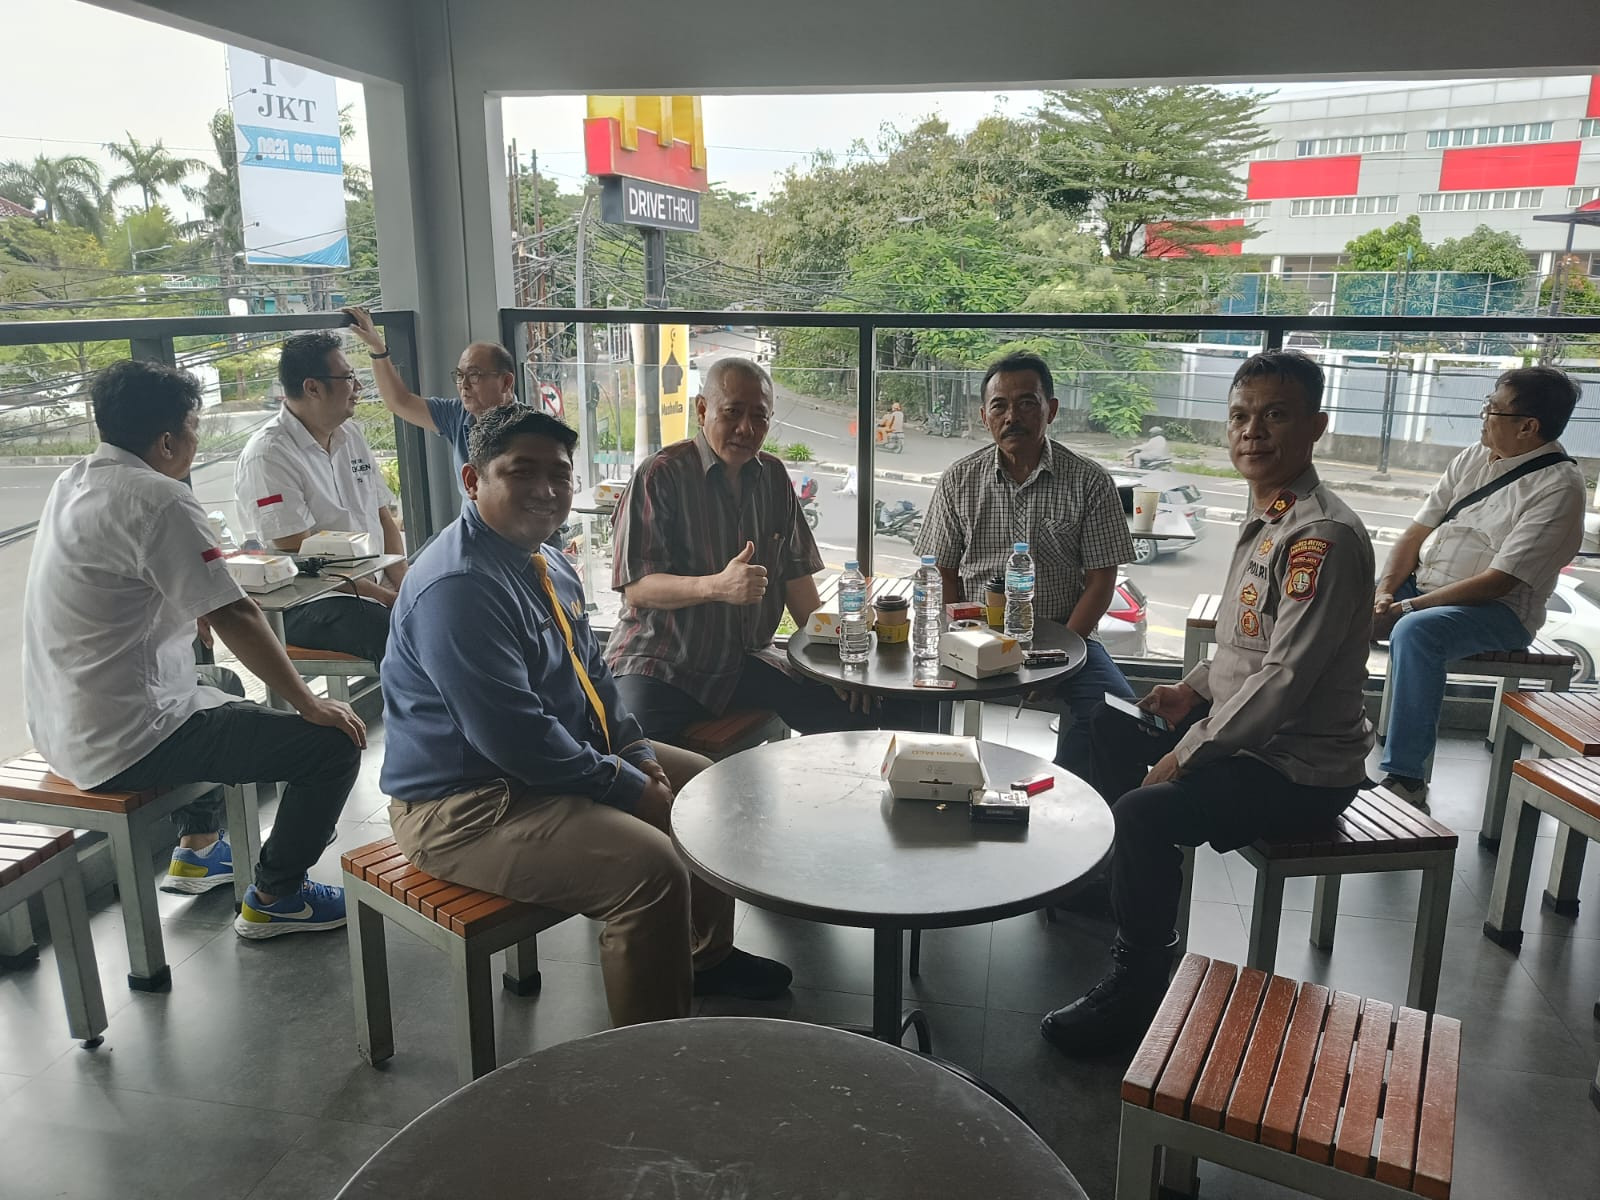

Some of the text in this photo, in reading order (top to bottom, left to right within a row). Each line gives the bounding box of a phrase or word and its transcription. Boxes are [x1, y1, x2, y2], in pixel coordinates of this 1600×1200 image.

[257, 92, 318, 123] JKT
[257, 136, 290, 161] 0821
[1246, 561, 1268, 580] POLRI
